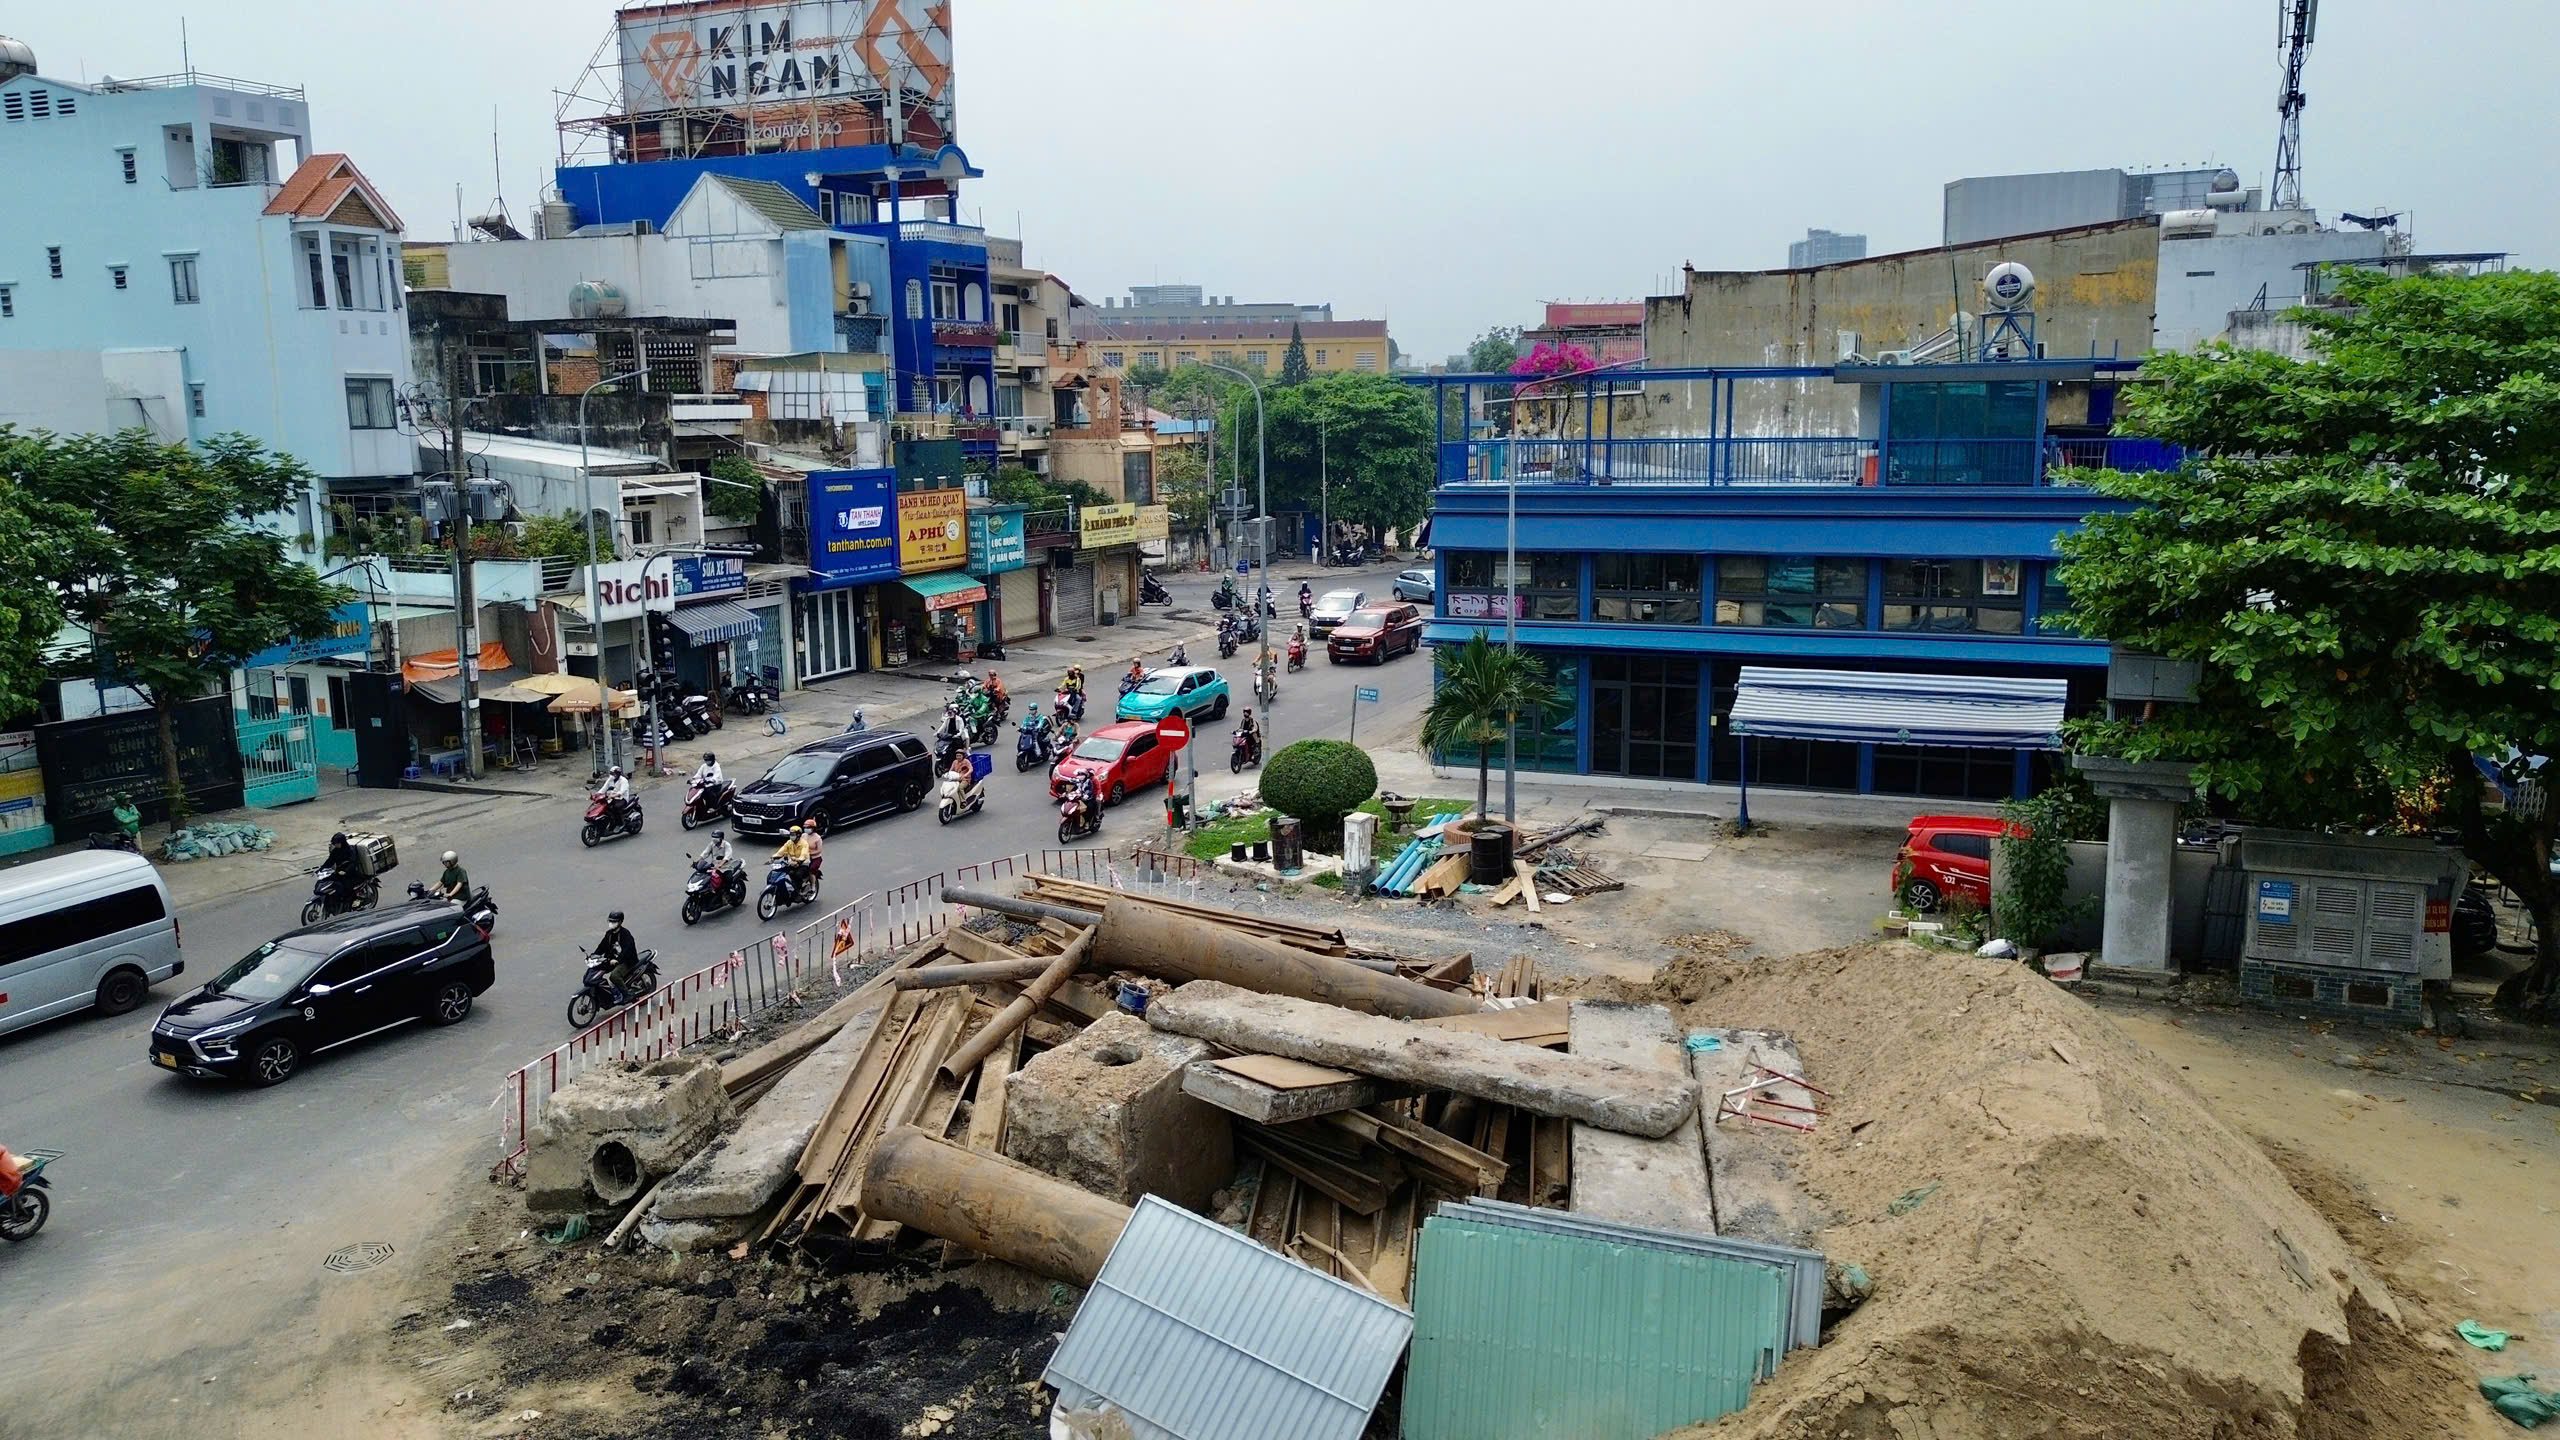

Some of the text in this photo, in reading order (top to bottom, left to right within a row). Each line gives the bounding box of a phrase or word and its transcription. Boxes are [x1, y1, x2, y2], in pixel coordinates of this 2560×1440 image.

[709, 19, 792, 60] KIM
[928, 495, 941, 507] HEO
[942, 493, 960, 507] QUAY
[906, 529, 918, 542] A
[827, 537, 893, 553] tanthanh.com.vn
[598, 572, 670, 608] Richi
